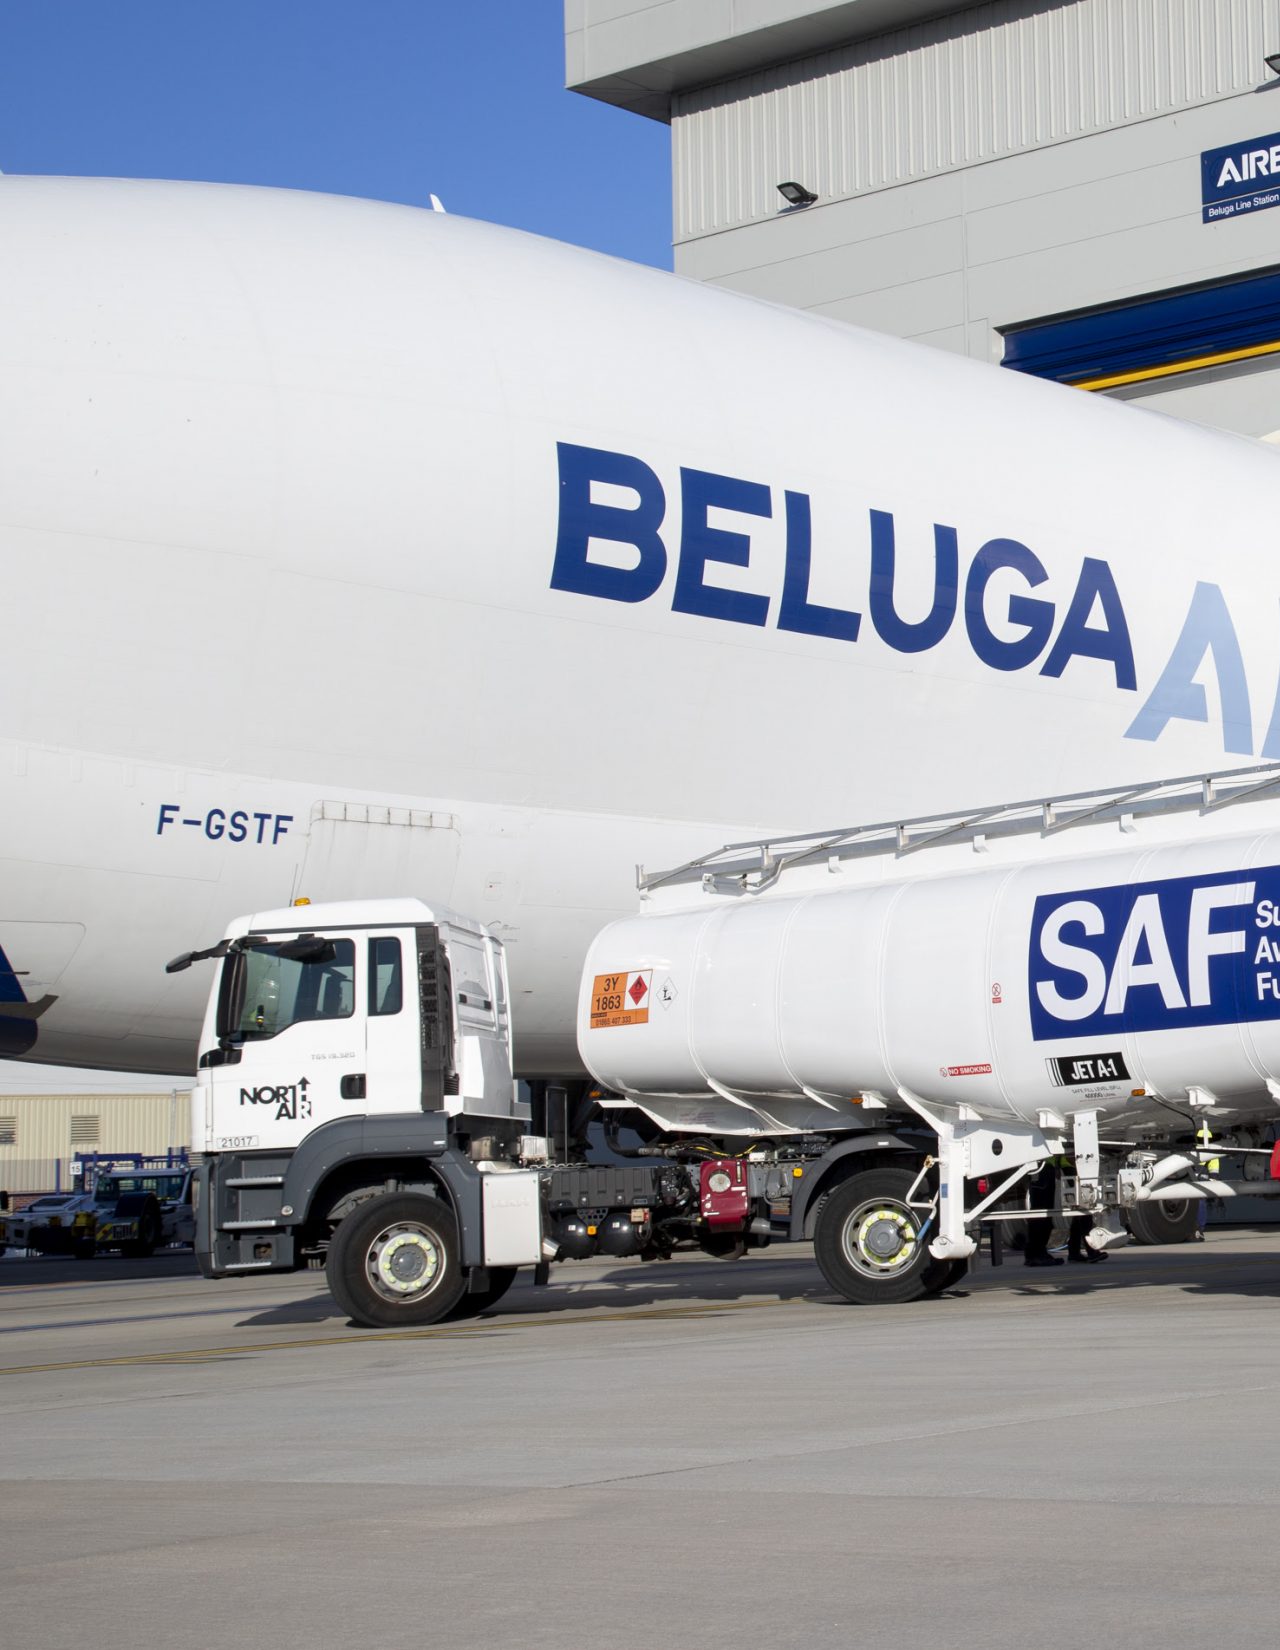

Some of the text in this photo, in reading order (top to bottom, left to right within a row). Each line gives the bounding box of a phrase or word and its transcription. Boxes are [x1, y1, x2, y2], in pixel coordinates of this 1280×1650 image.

[1208, 193, 1280, 217] Beluga Line Station
[549, 441, 1138, 692] BELUGA
[157, 804, 294, 845] F-GSTF
[1036, 881, 1257, 1021] SAF
[603, 976, 620, 992] 3Y
[596, 995, 621, 1011] 1863
[949, 1065, 991, 1075] NO SMOKING
[1071, 1058, 1118, 1080] JET A-1
[221, 1136, 253, 1147] 21017
[71, 1165, 81, 1173] 15
